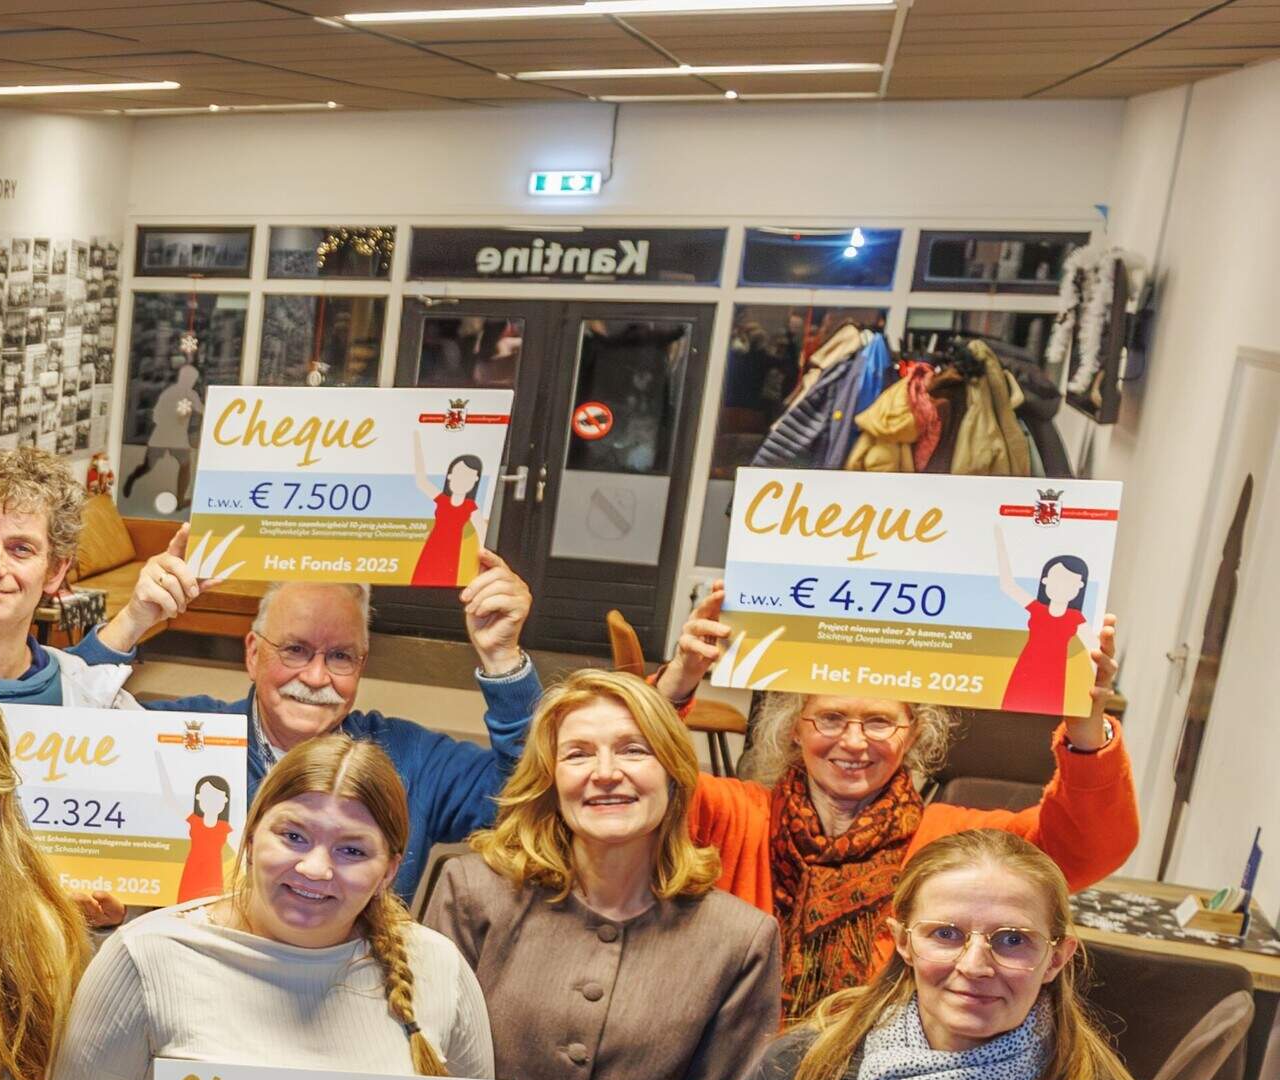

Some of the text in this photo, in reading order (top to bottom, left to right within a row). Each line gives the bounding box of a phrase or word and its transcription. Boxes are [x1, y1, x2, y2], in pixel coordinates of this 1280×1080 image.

[211, 398, 376, 468] Cheque
[207, 482, 371, 511] t.w.v. € 7.500
[742, 479, 944, 562] Cheque
[264, 554, 398, 572] Het Fonds 2025
[739, 577, 945, 616] t.w.v. € 4.750
[811, 663, 983, 693] Het Fonds 2025
[14, 731, 119, 782] eque
[32, 797, 126, 828] 2.324
[59, 874, 161, 894] Fonds 2025
